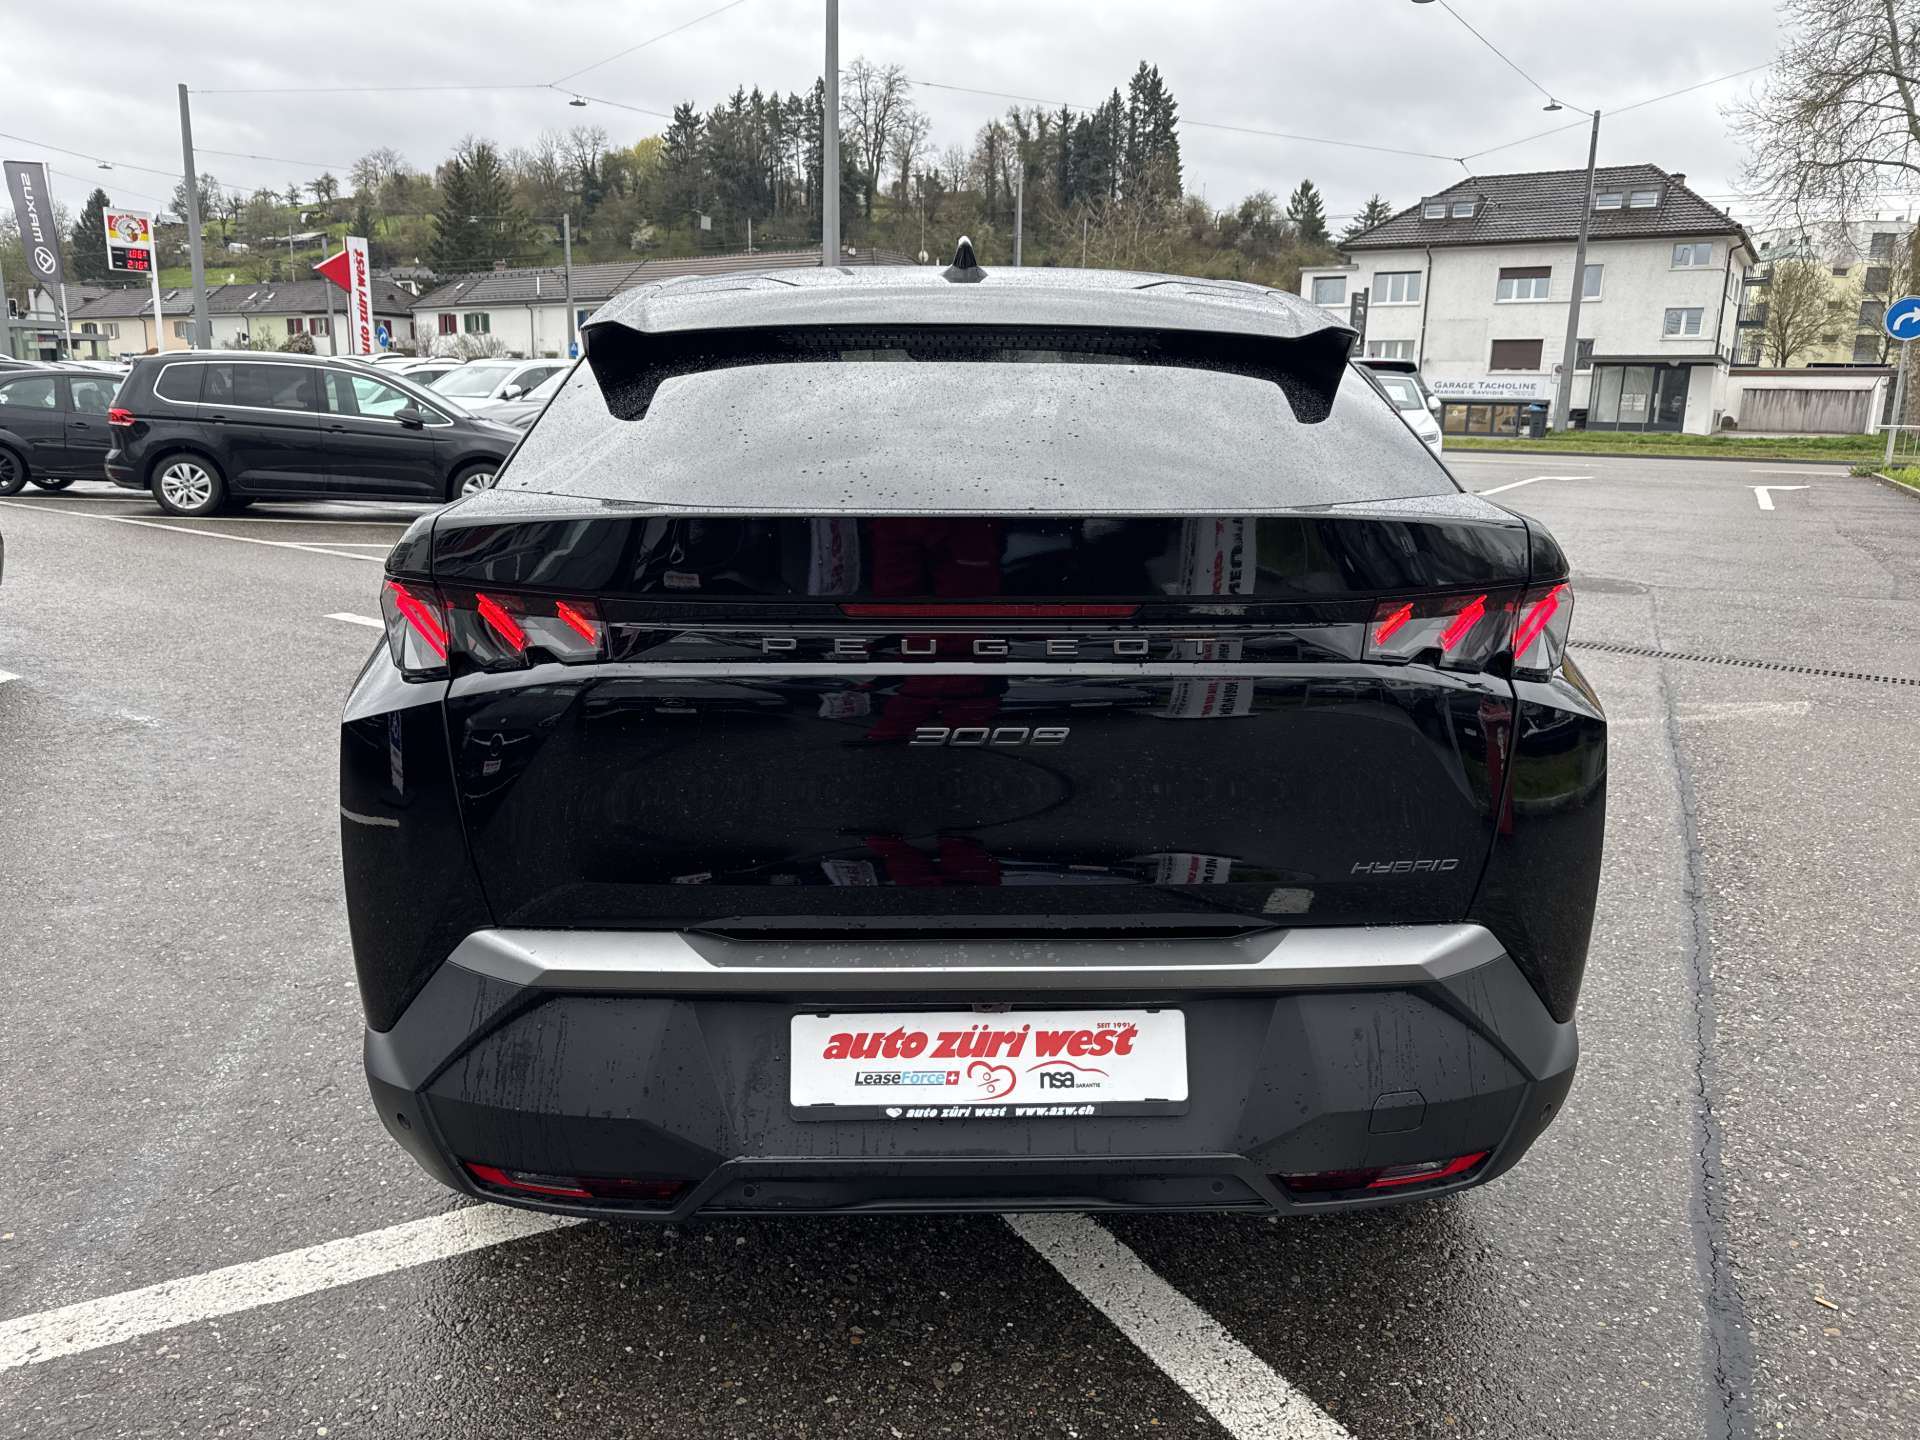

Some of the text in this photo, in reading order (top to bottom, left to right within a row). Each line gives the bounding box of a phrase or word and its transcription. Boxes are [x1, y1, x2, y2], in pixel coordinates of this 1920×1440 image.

[354, 248, 367, 287] west
[360, 325, 371, 354] uto
[1434, 381, 1537, 390] GARAGE TACHOLINE
[761, 637, 1216, 656] PEUGEOT
[908, 727, 1071, 746] 3008
[1350, 859, 1460, 875] HYBRID
[822, 1022, 1139, 1060] auto züri west
[855, 1071, 945, 1086] LeaseForce
[1040, 1071, 1075, 1089] nsa
[906, 1104, 1095, 1118] auto züri west www.azw.ch
